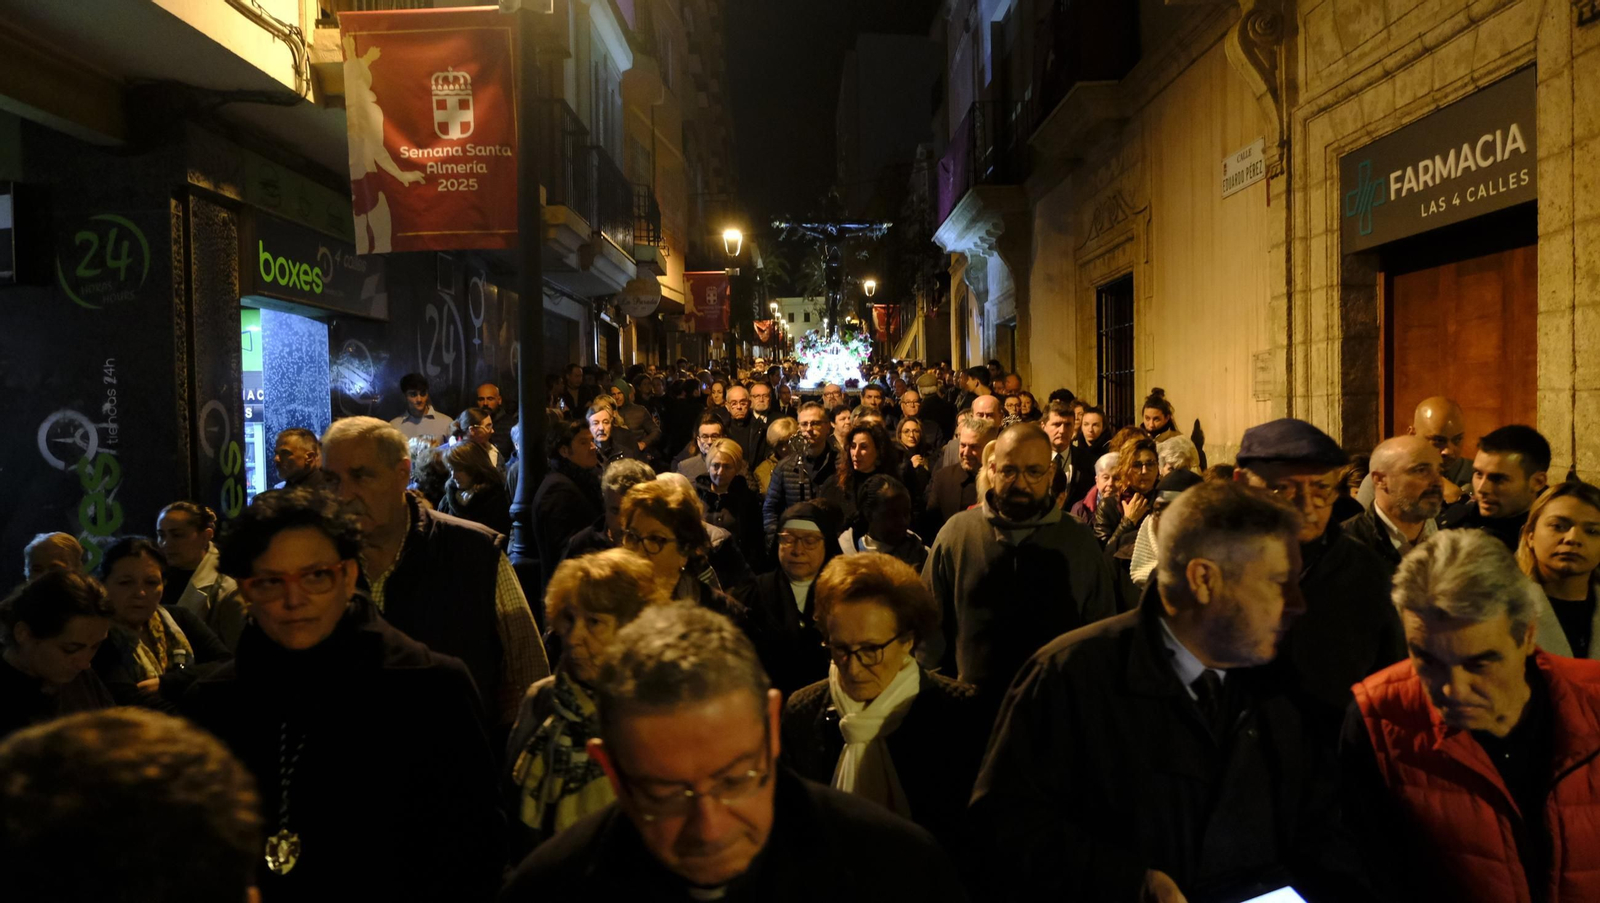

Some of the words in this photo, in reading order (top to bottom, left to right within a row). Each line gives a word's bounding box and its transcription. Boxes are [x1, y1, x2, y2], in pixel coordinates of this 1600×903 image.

[400, 146, 463, 158] Semana
[466, 143, 512, 156] Santa
[426, 160, 488, 174] Almería
[1236, 147, 1252, 163] CALLE
[1389, 122, 1527, 201] FARMACIA
[438, 178, 478, 192] 2025
[1222, 170, 1244, 193] EDUARDO
[1246, 159, 1263, 181] PÉREZ
[1420, 197, 1446, 218] LAS
[1452, 192, 1460, 206] 4
[1476, 168, 1529, 202] CALLES
[74, 227, 133, 281] 24
[258, 239, 323, 294] boxes
[425, 303, 456, 384] 24
